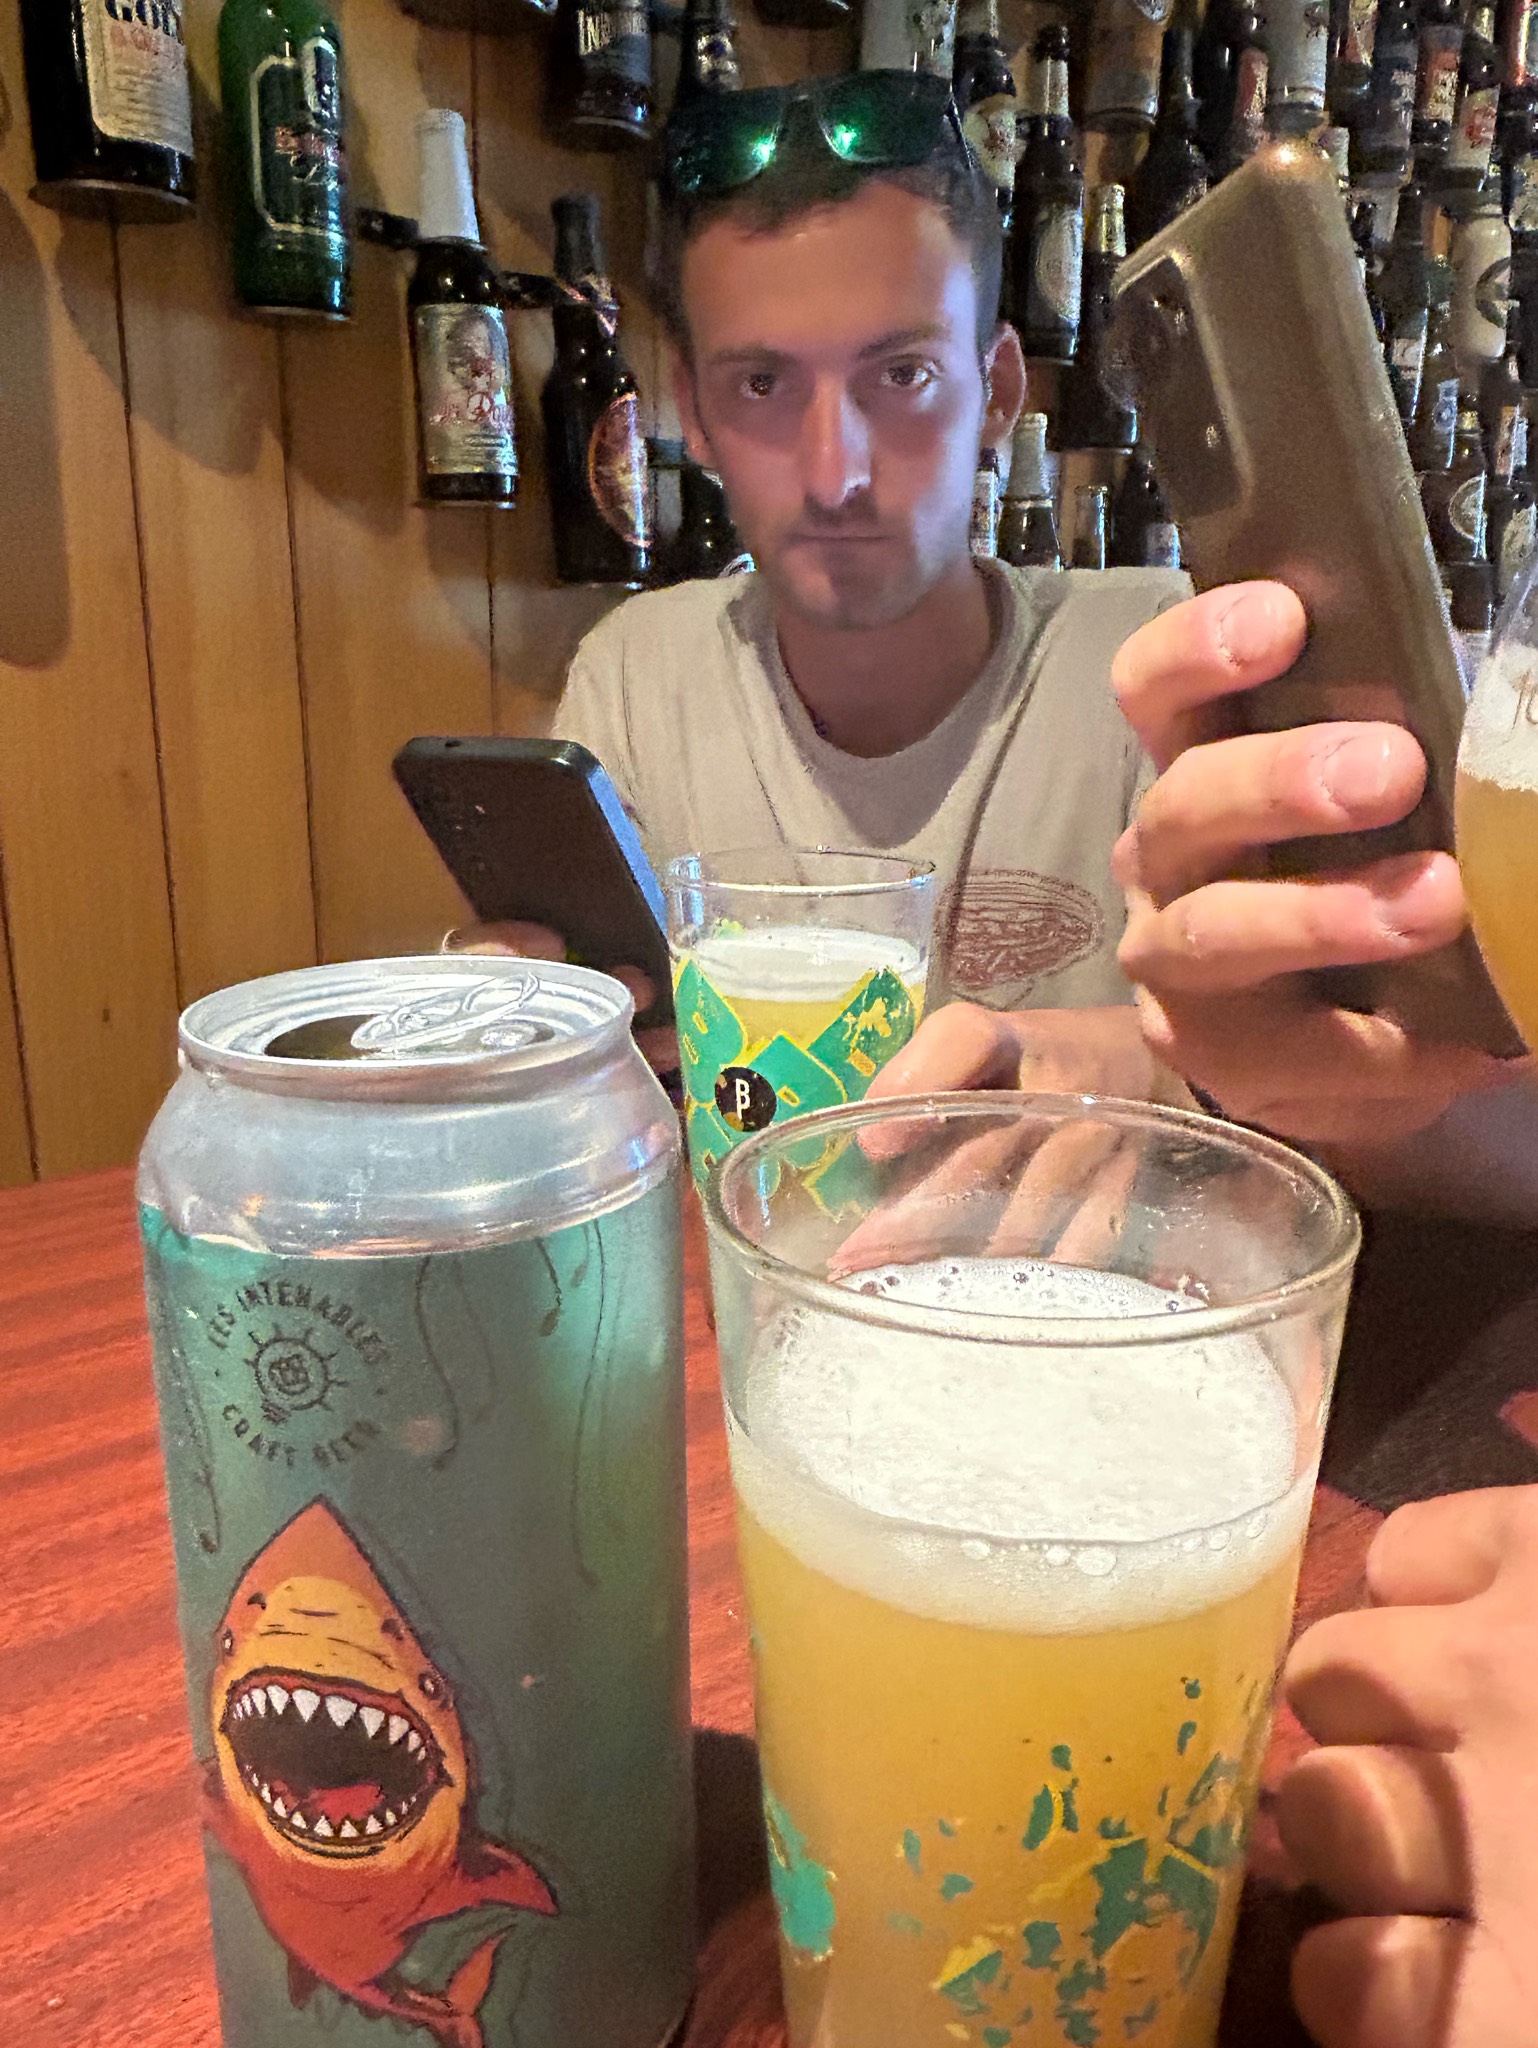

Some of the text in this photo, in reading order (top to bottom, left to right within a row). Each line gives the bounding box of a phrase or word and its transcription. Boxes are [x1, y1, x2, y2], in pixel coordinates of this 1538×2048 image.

[207, 1280, 391, 1366] LES INTENABLES
[222, 1403, 298, 1468] CRAFT
